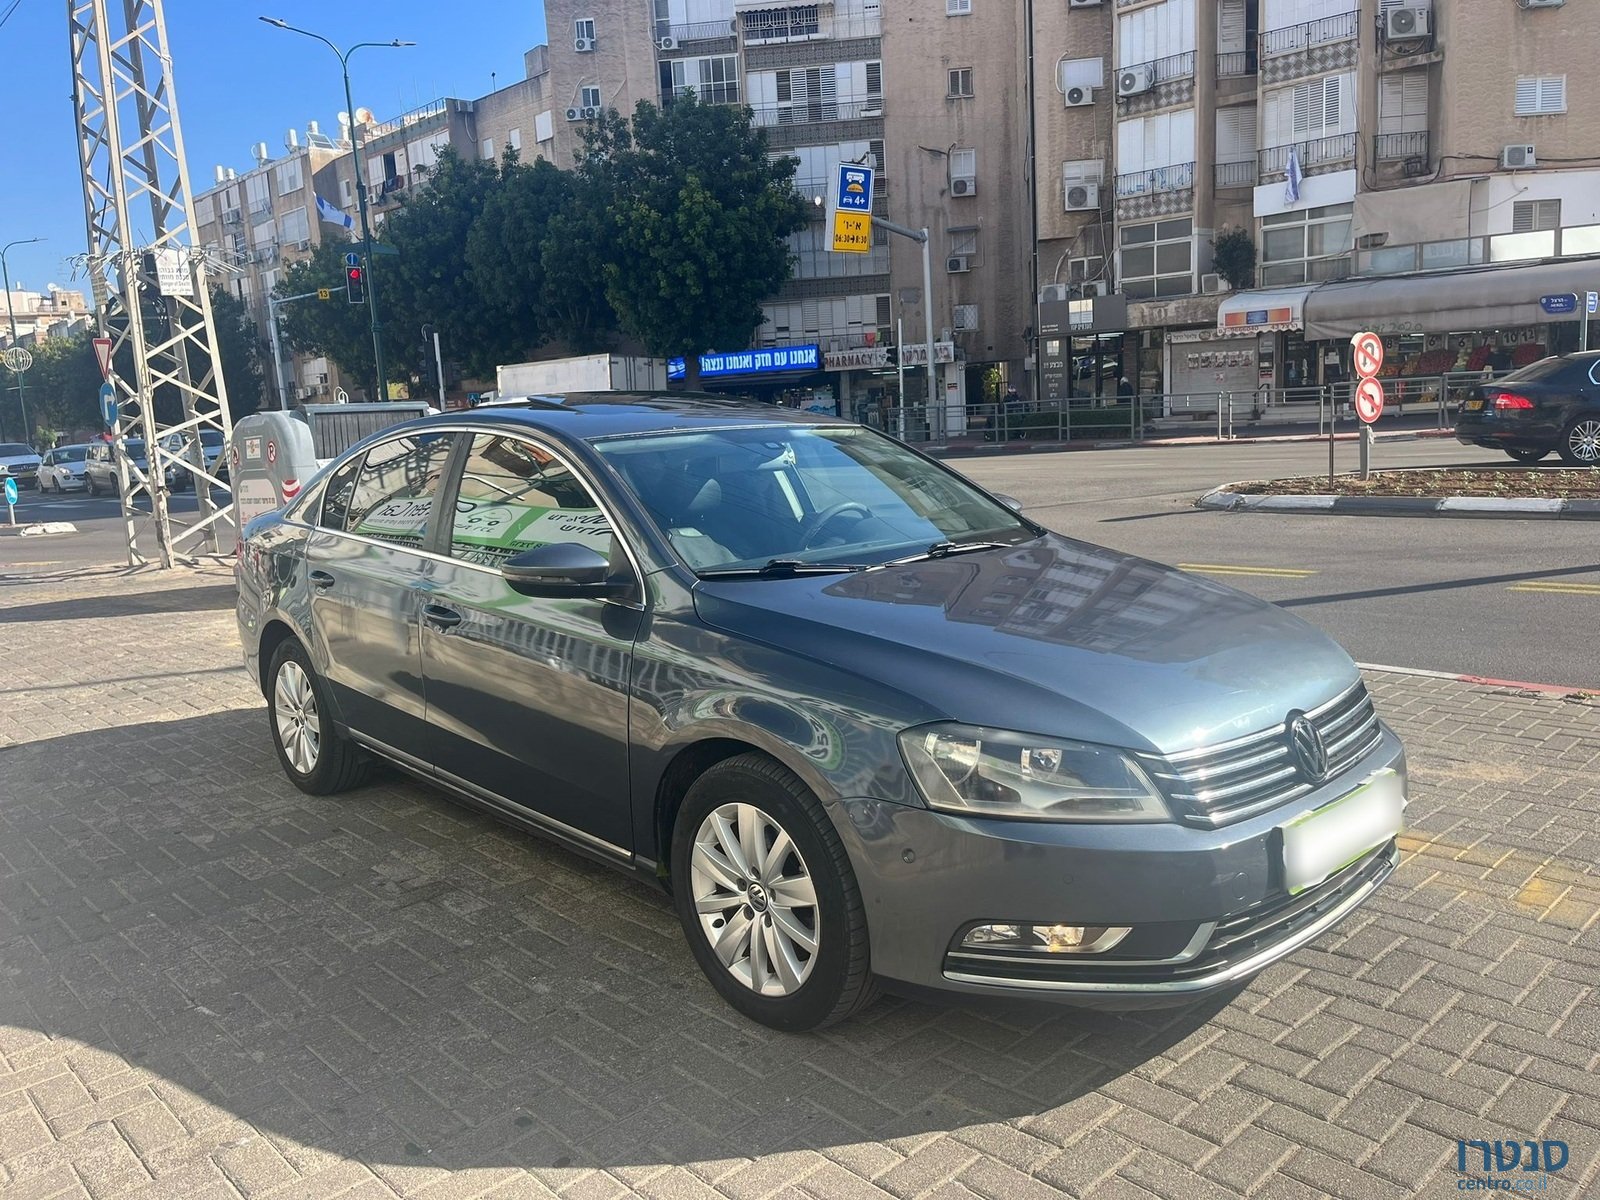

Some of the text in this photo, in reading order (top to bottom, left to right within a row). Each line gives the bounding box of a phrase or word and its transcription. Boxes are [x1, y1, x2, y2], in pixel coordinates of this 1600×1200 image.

[854, 195, 865, 205] 4+
[1504, 332, 1517, 343] 10
[701, 349, 816, 372] אנחנו עם חזק ואנחנו ננצה!
[825, 353, 873, 367] PHARMACY
